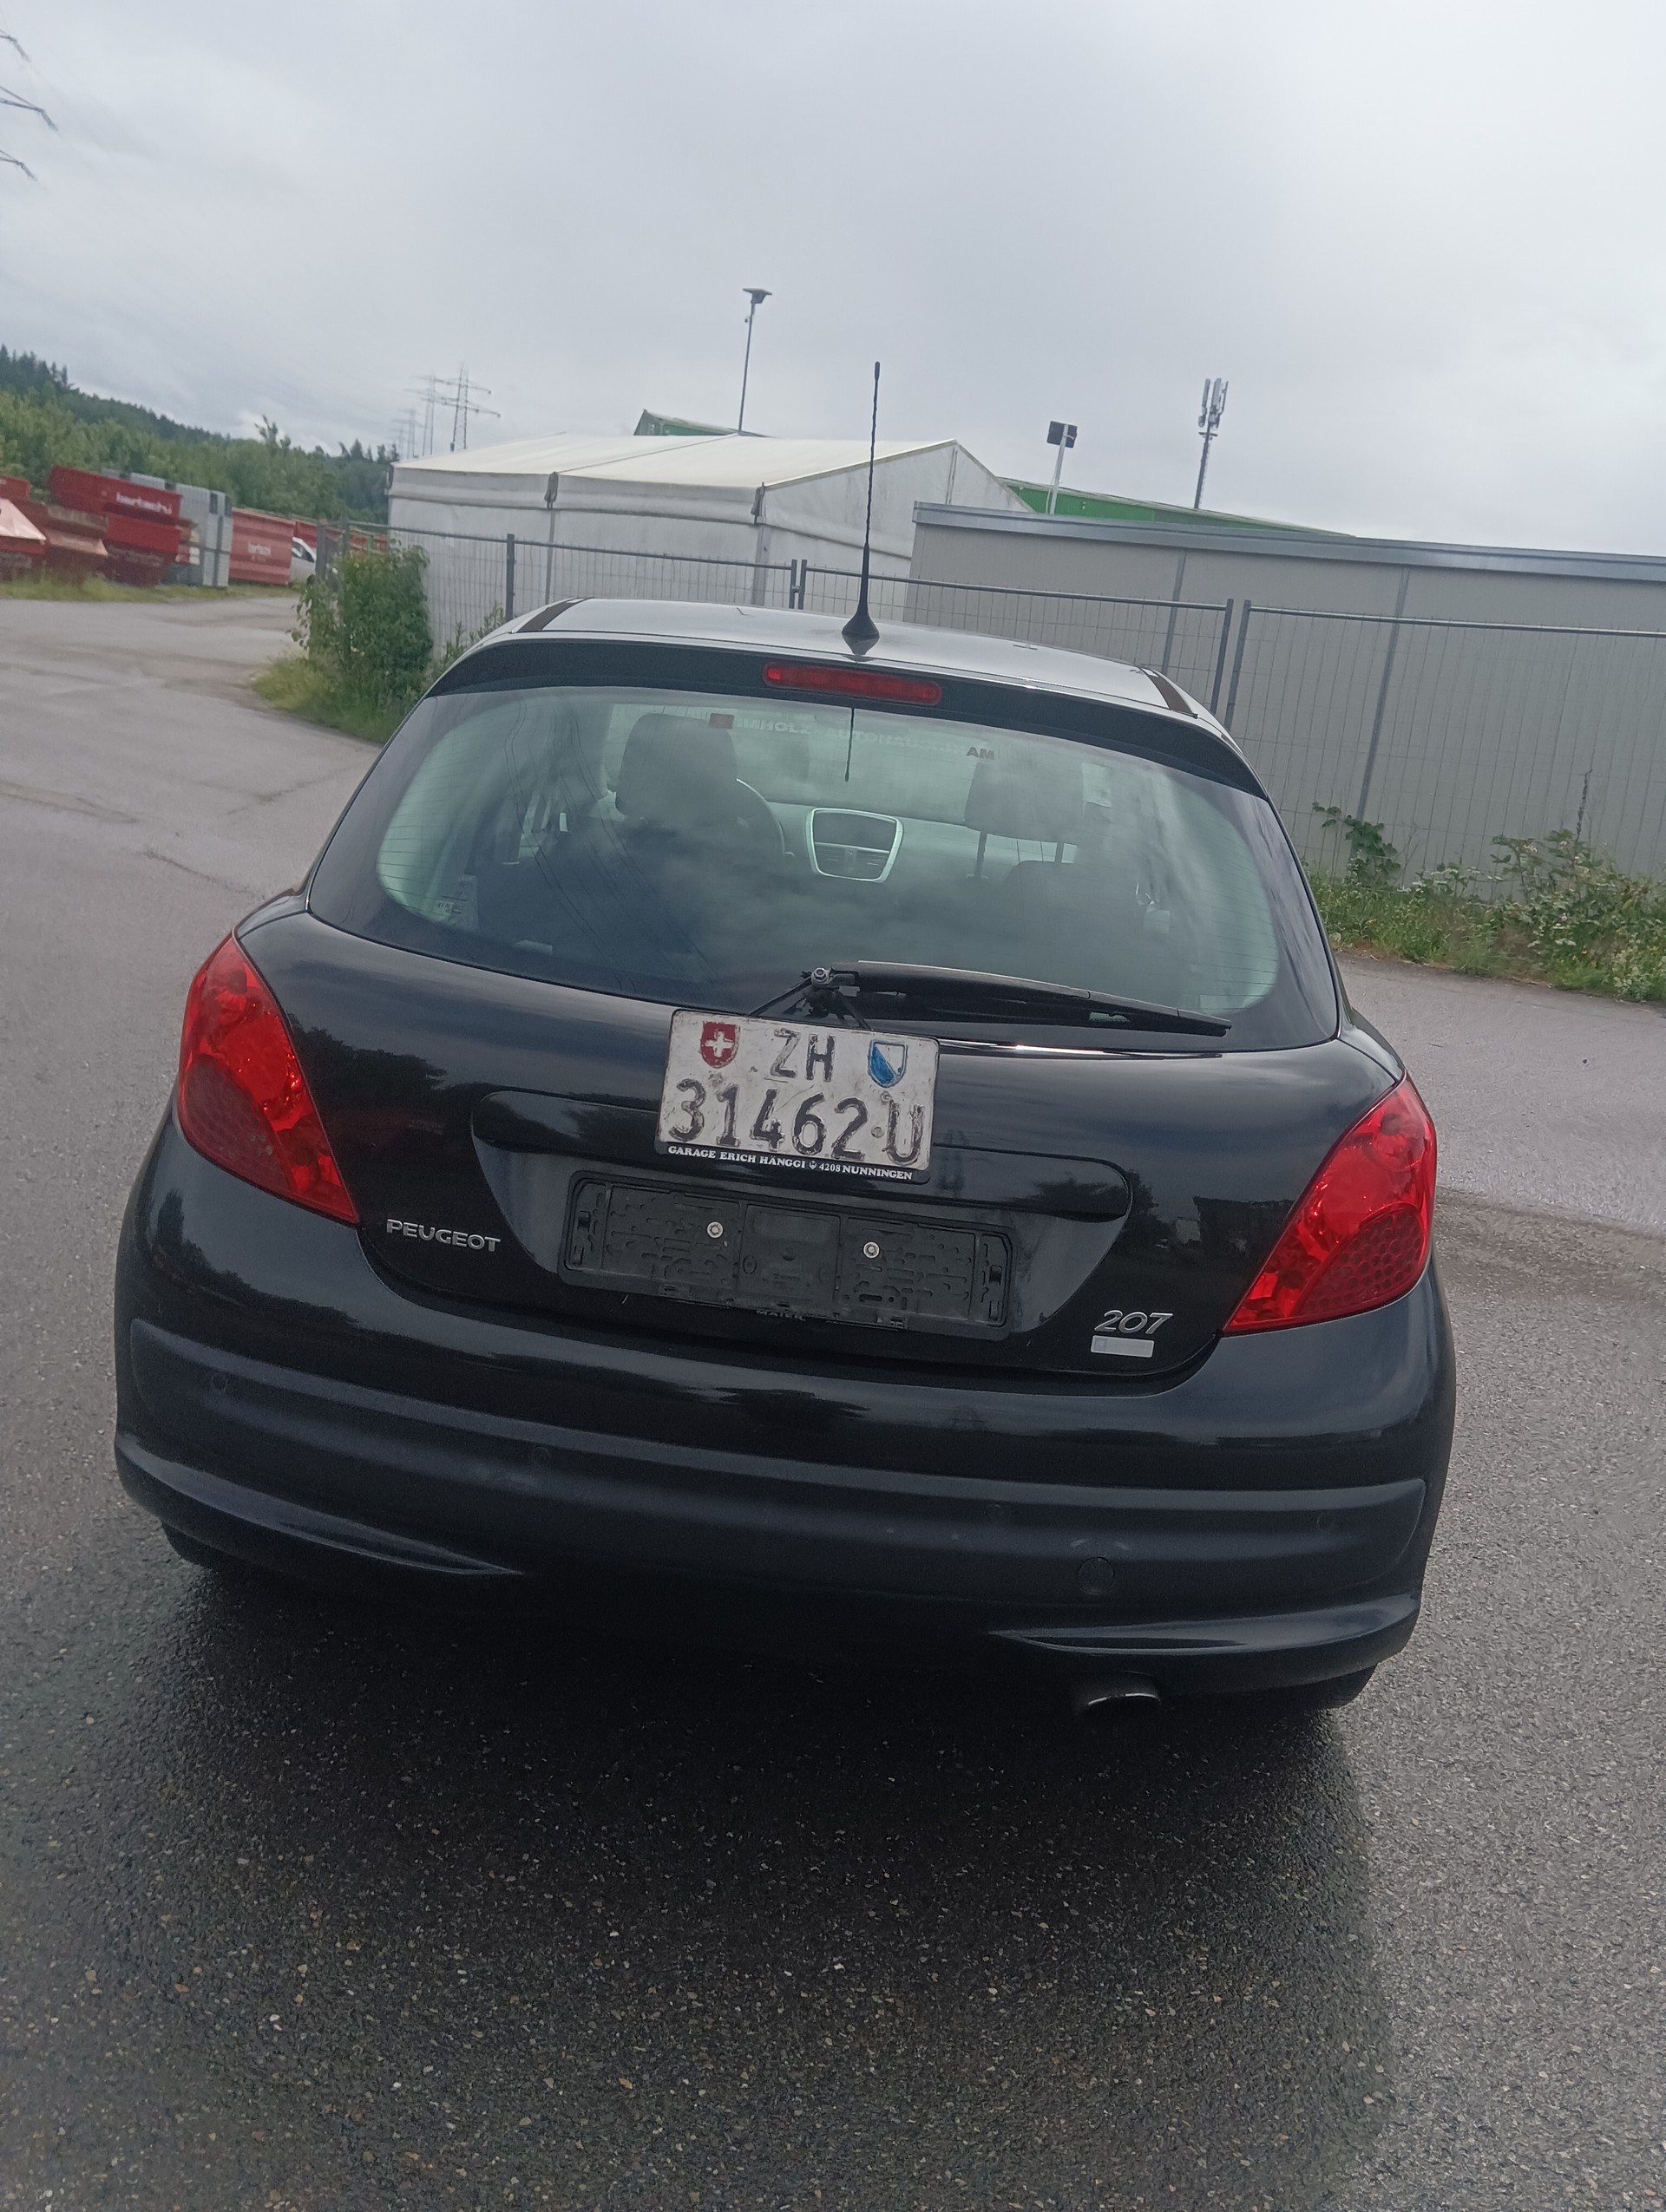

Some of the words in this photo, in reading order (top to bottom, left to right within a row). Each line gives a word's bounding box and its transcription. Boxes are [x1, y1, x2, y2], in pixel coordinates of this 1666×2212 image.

[770, 1027, 836, 1083] ZH
[668, 1145, 716, 1159] GARAGE
[719, 1151, 757, 1163] ERICH
[759, 1155, 806, 1169] HÄNGGI
[818, 1162, 841, 1173] 4208
[842, 1165, 913, 1181] NUNNINGEN
[386, 1219, 501, 1252] PEUGEOT
[1094, 1309, 1173, 1334] 207
